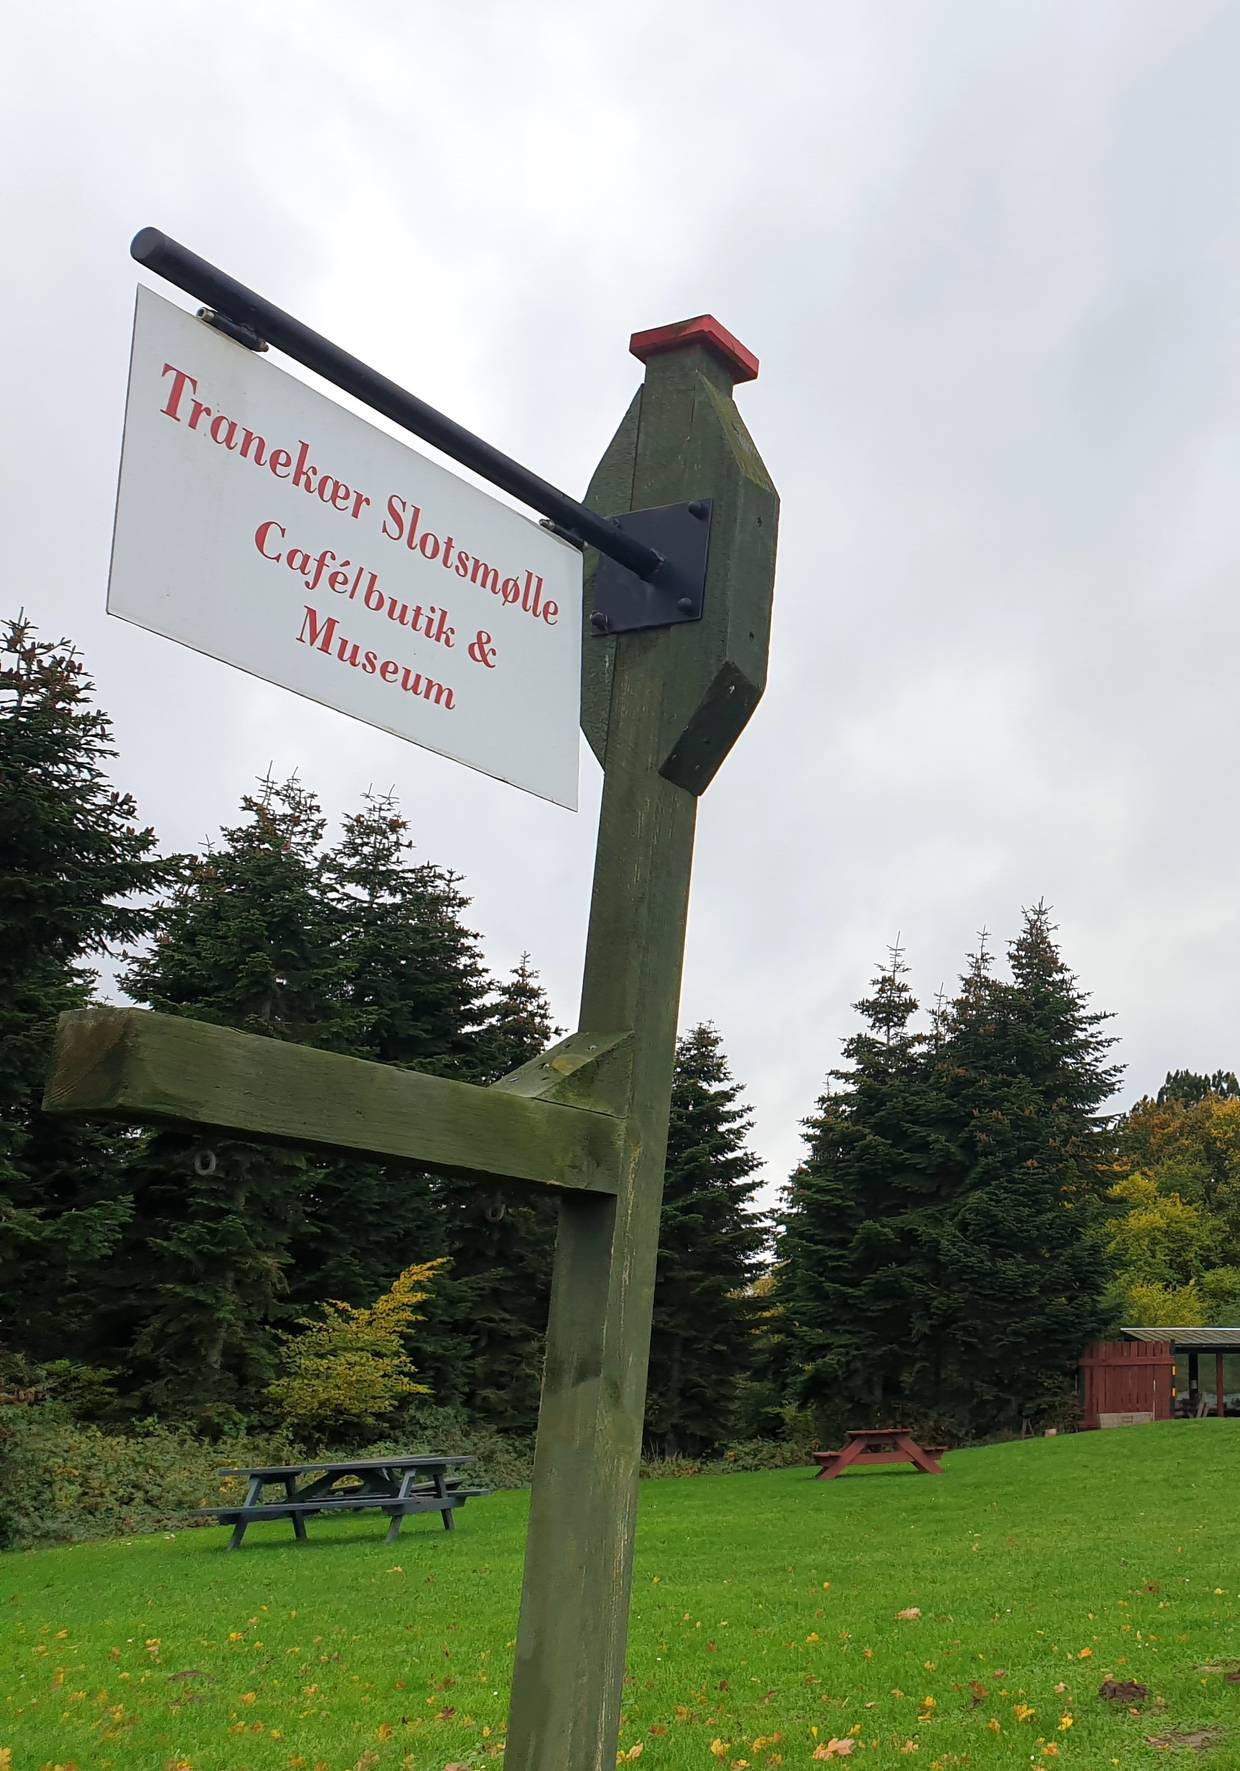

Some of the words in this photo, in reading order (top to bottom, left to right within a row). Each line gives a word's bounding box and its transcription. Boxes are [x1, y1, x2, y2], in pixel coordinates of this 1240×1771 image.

[160, 363, 371, 520] Tranekær
[381, 494, 559, 626] Slotsmølle
[254, 520, 455, 648] Café/butik
[467, 631, 496, 669] &
[296, 605, 456, 710] Museum
